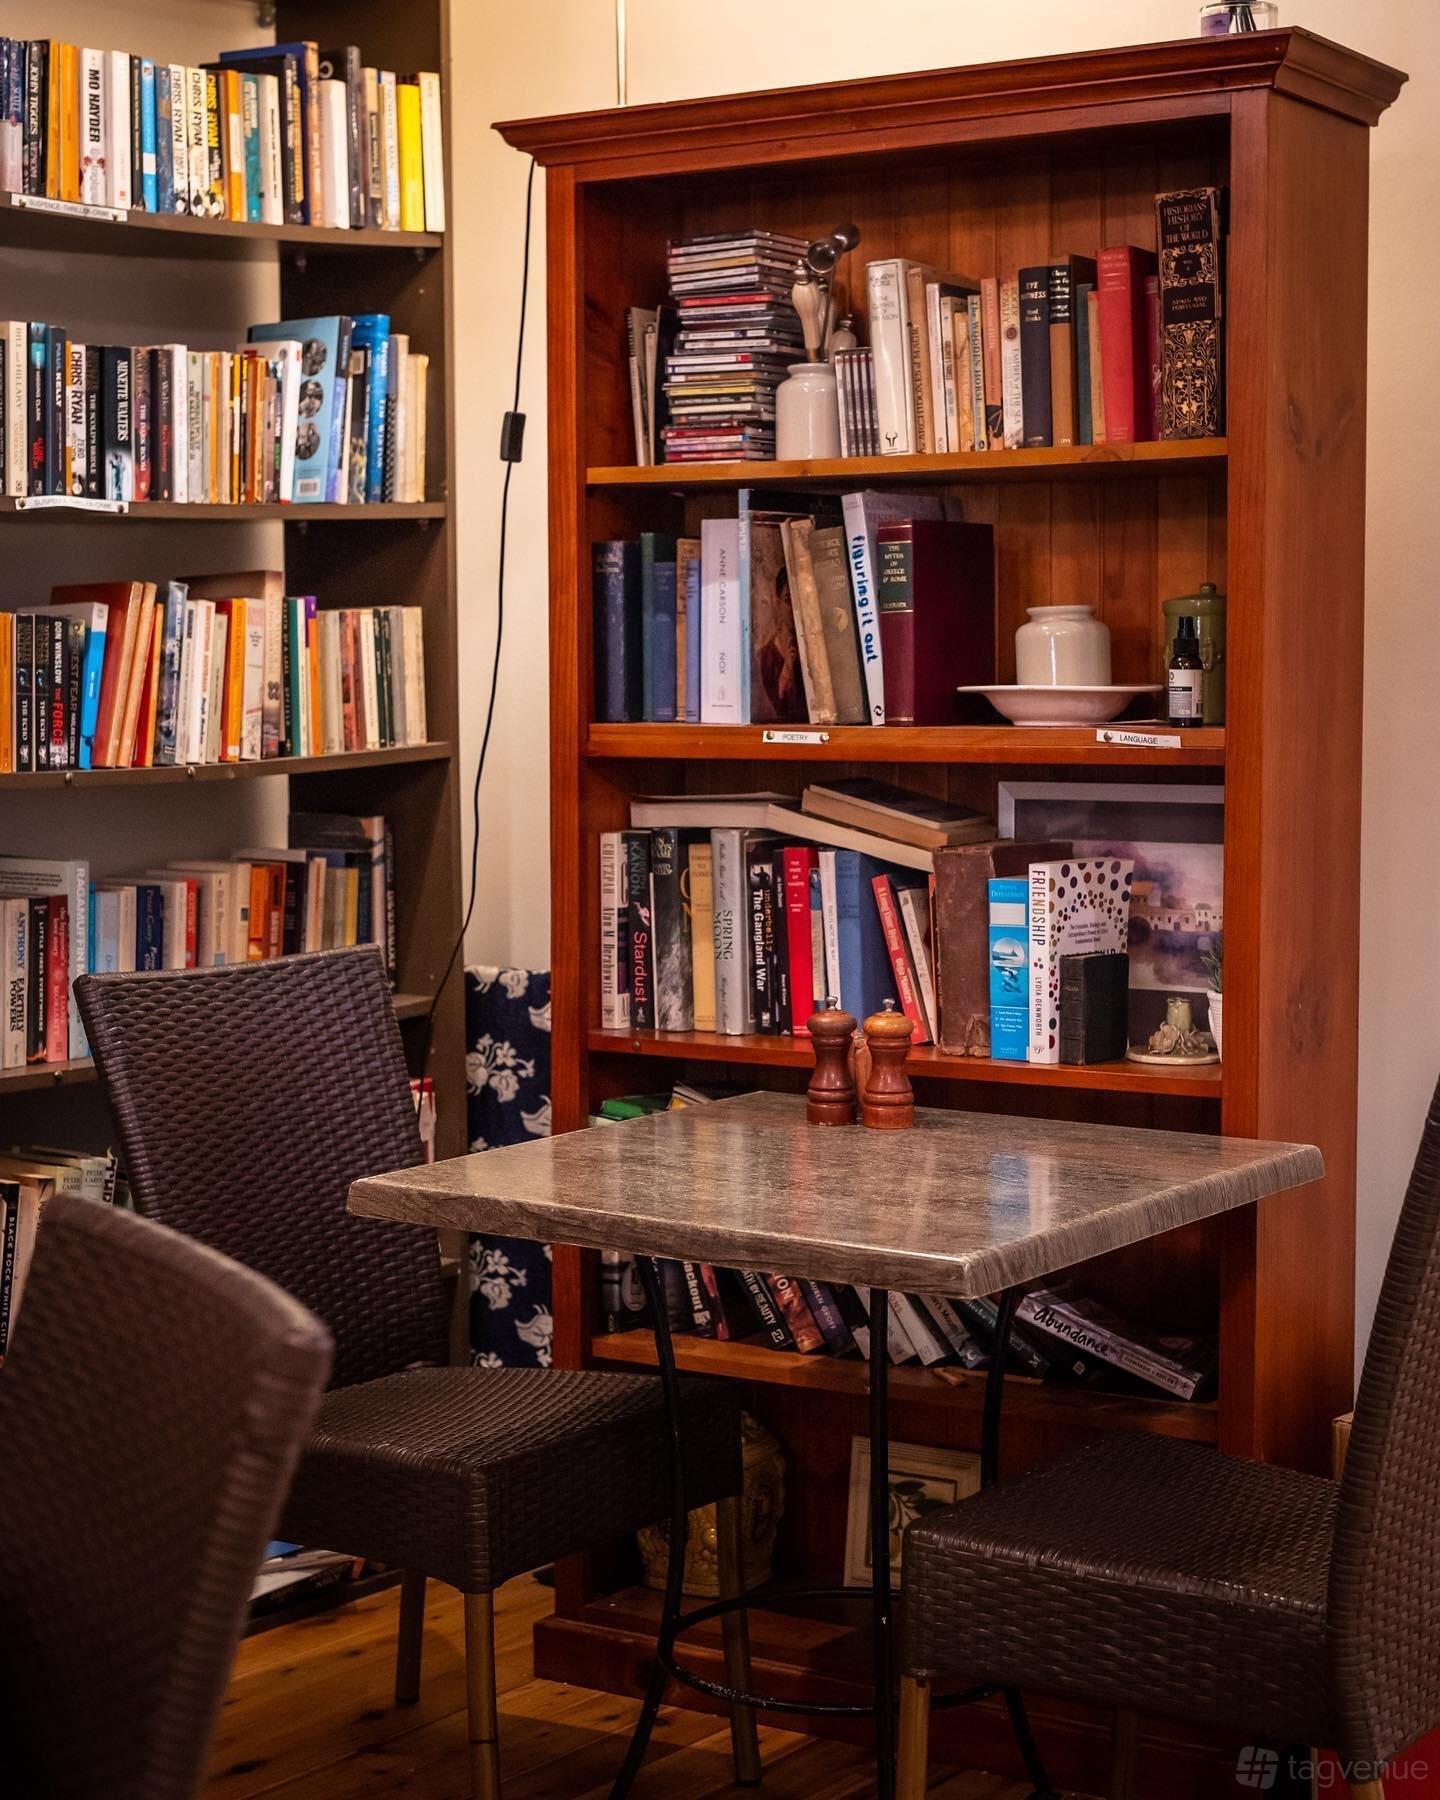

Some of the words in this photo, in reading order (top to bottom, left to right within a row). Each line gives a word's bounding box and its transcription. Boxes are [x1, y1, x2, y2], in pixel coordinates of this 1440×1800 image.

[29, 63, 39, 93] JOHN
[88, 69, 101, 91] MO
[172, 71, 183, 104] CHRIS
[191, 72, 203, 108] CHRIS
[207, 75, 218, 110] CHRIS
[88, 93, 101, 143] HAYDER
[173, 108, 184, 143] RYAN
[192, 111, 205, 146] RYAN
[207, 112, 220, 148] RYAN
[1167, 211, 1205, 225] HISTORY
[1179, 223, 1190, 232] OF
[1166, 233, 1180, 244] THE
[1180, 229, 1209, 243] WORLD
[970, 300, 979, 317] The
[1171, 298, 1191, 307] SPAIN
[1193, 295, 1208, 304] AND
[972, 320, 981, 367] WOODEN
[71, 351, 83, 386] CHRIS
[116, 359, 128, 400] MINETTE
[72, 389, 83, 425] RYAN
[89, 394, 97, 410] THE
[139, 404, 147, 420] THE
[117, 401, 129, 442] WALTERS
[77, 438, 85, 459] ZERO
[718, 548, 727, 577] ANNE
[851, 535, 870, 608] figuring
[890, 575, 907, 583] ROME
[718, 581, 727, 624] CARSON
[54, 621, 63, 641] DON
[860, 611, 873, 627] it
[54, 641, 63, 684] WINSLOW
[718, 652, 727, 675] NOX
[864, 632, 880, 663] out
[70, 680, 79, 712] FEAR
[21, 717, 29, 741] ECHO
[39, 718, 47, 742] ECHO
[51, 701, 64, 746] FORCE
[782, 733, 809, 741] POETRY
[1119, 733, 1159, 744] LANGUAGE
[630, 840, 640, 895] KANON
[75, 867, 86, 962] RAGAMUFFIN
[752, 889, 764, 910] The
[876, 893, 890, 912] Long
[1031, 870, 1046, 946] FRIENDSHIP
[602, 906, 615, 927] Alan
[763, 889, 773, 952] underbelly
[881, 912, 895, 929] Time
[16, 911, 26, 969] ANTHONY
[714, 910, 722, 961] MOON
[724, 909, 734, 961] SPRING
[753, 912, 767, 965] Gangland
[885, 928, 900, 951] Dying
[602, 943, 615, 995] Dershowitz
[633, 930, 649, 1003] Stardust
[755, 967, 767, 991] War
[893, 957, 906, 975] Olga
[899, 976, 913, 1004] Masters
[1034, 976, 1043, 996] LYDIA
[9, 979, 18, 1033] POWERS
[16, 977, 25, 1033] EARTHLY
[1034, 998, 1043, 1036] DENWORTH
[7, 1216, 16, 1249] BLACK
[4, 1253, 13, 1281] ROCK
[1, 1285, 11, 1318] WHITE
[748, 1284, 759, 1295] BY
[753, 1292, 777, 1326] BEAUTY
[0, 1321, 8, 1344] CITY
[1033, 1307, 1108, 1354] Abundance
